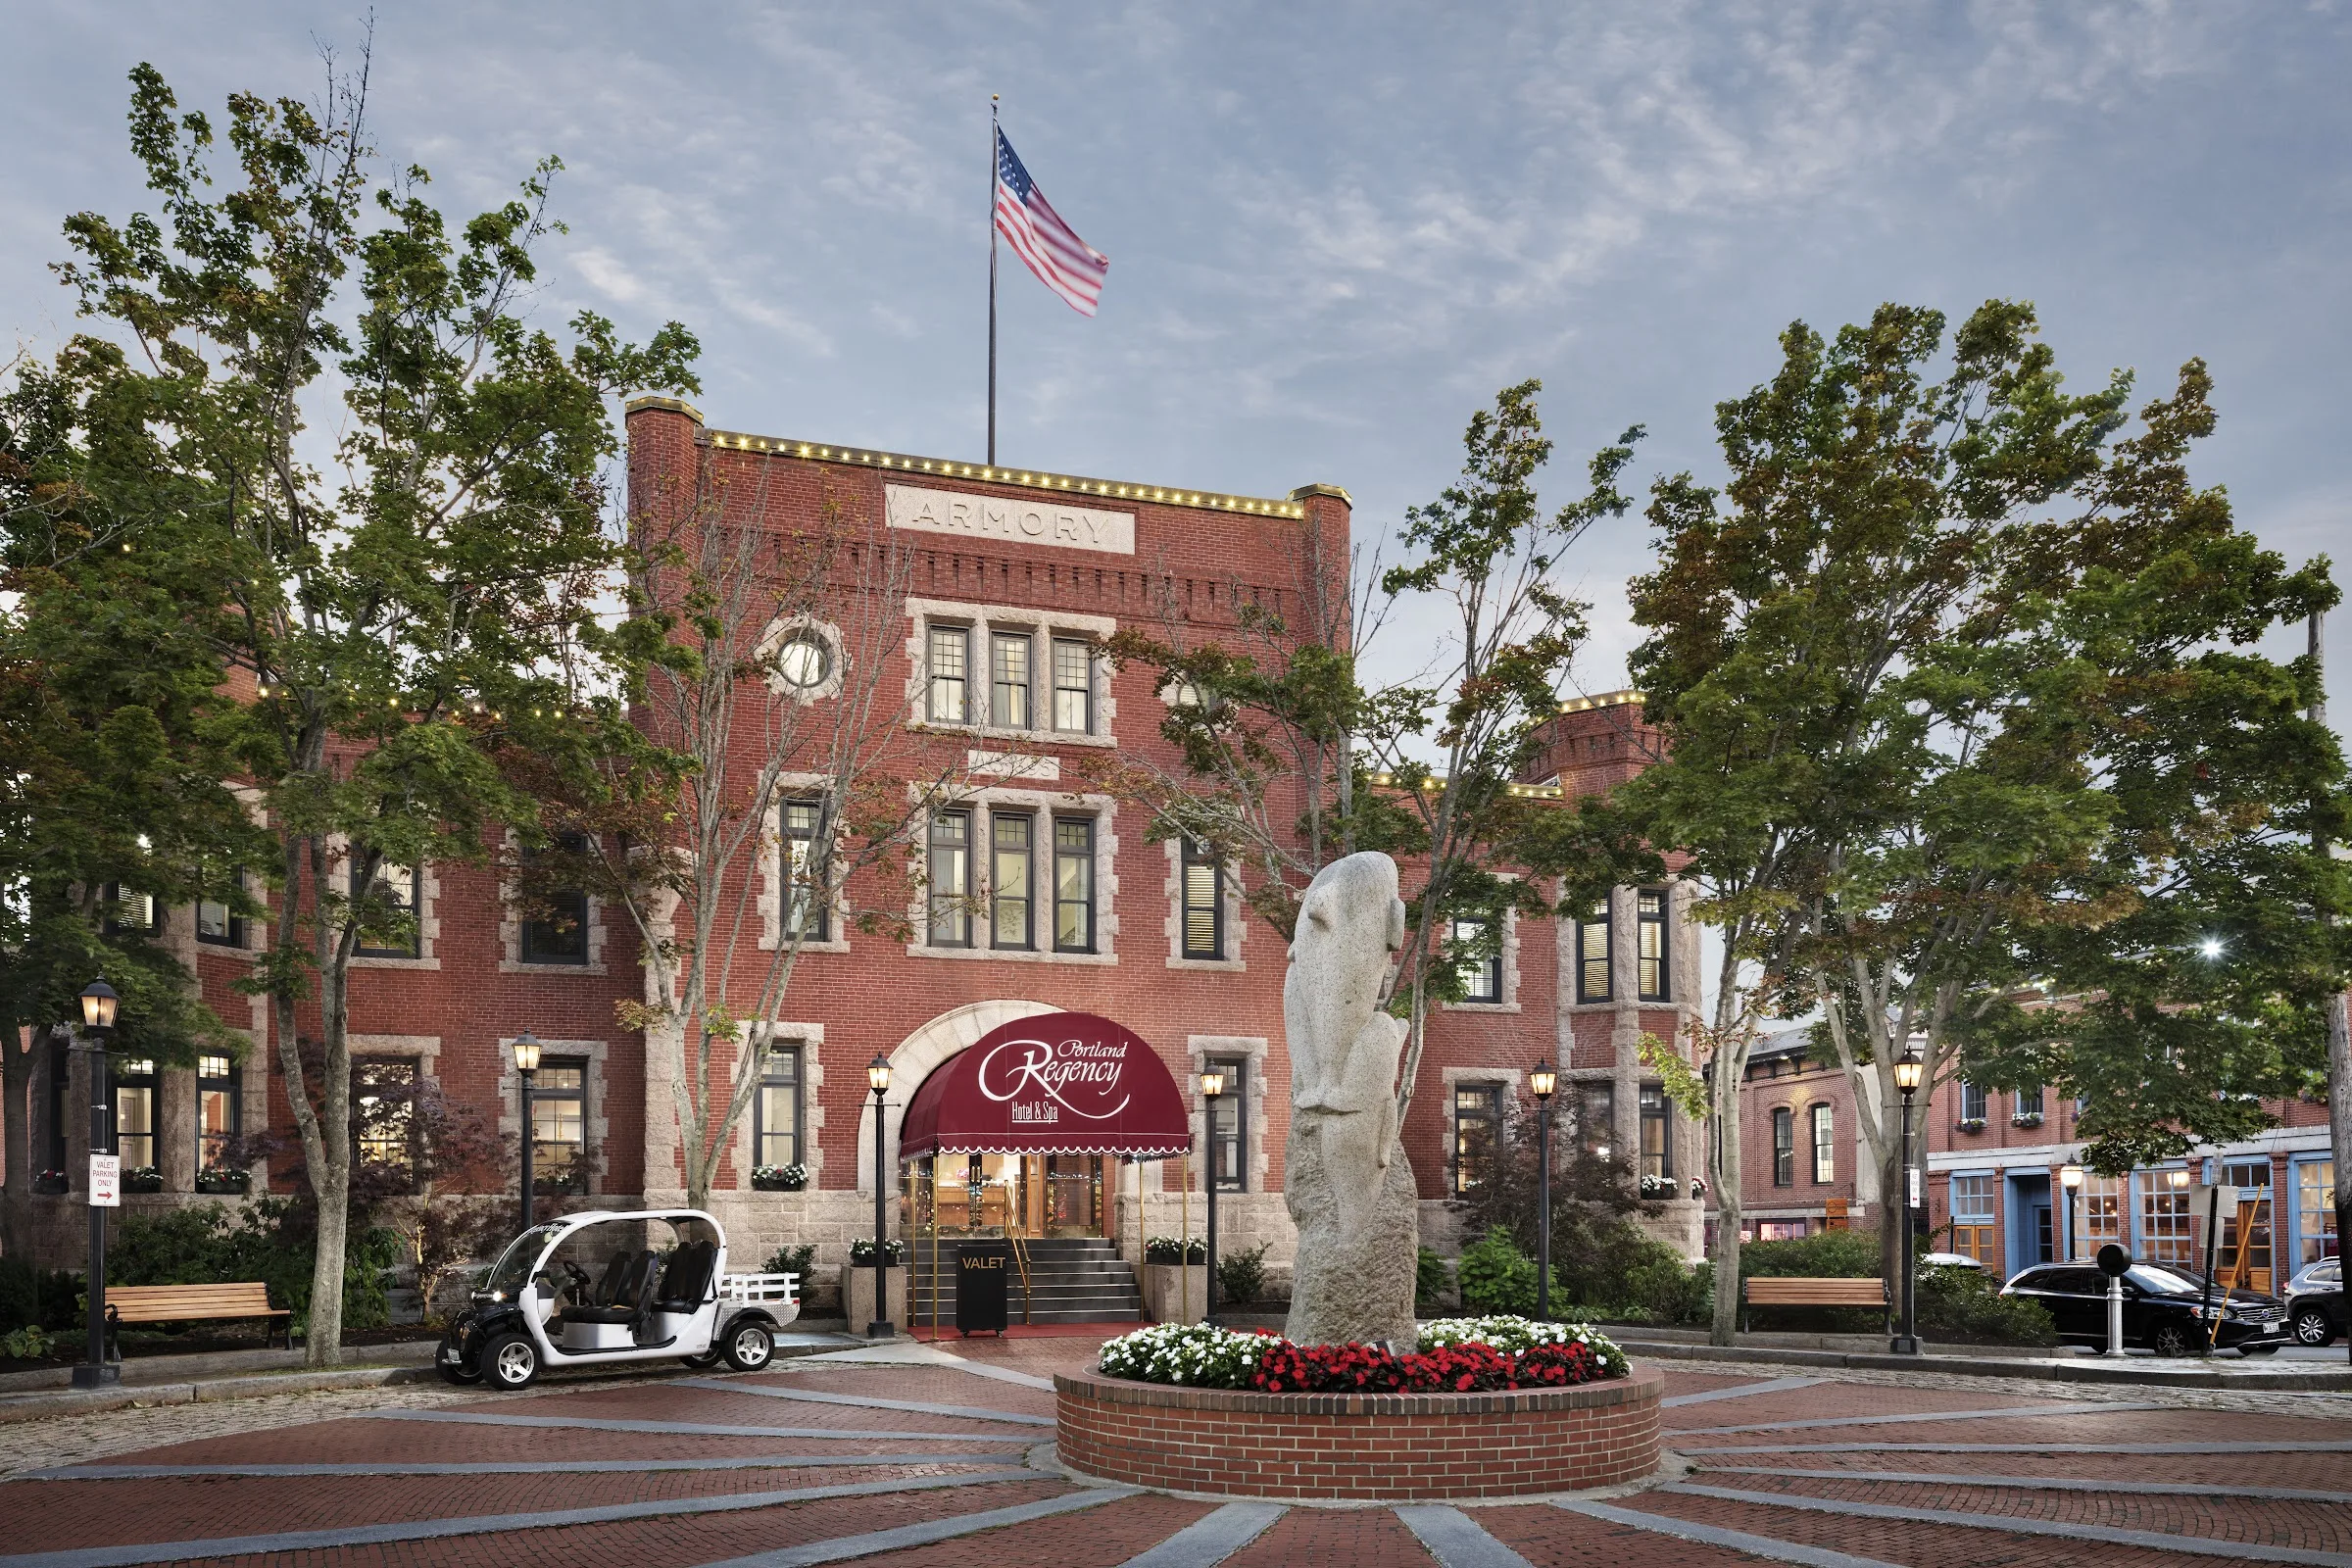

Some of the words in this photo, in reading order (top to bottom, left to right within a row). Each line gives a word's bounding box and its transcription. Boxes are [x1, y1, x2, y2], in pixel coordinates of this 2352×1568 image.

[912, 499, 1109, 543] ARMORY
[1057, 1039, 1129, 1058] Portland
[978, 1039, 1131, 1119] Regency
[1011, 1101, 1033, 1121] Hotel
[1034, 1101, 1042, 1120] &
[1043, 1101, 1058, 1124] Spa
[92, 1169, 118, 1178] PARKING
[961, 1256, 1006, 1269] VALET
